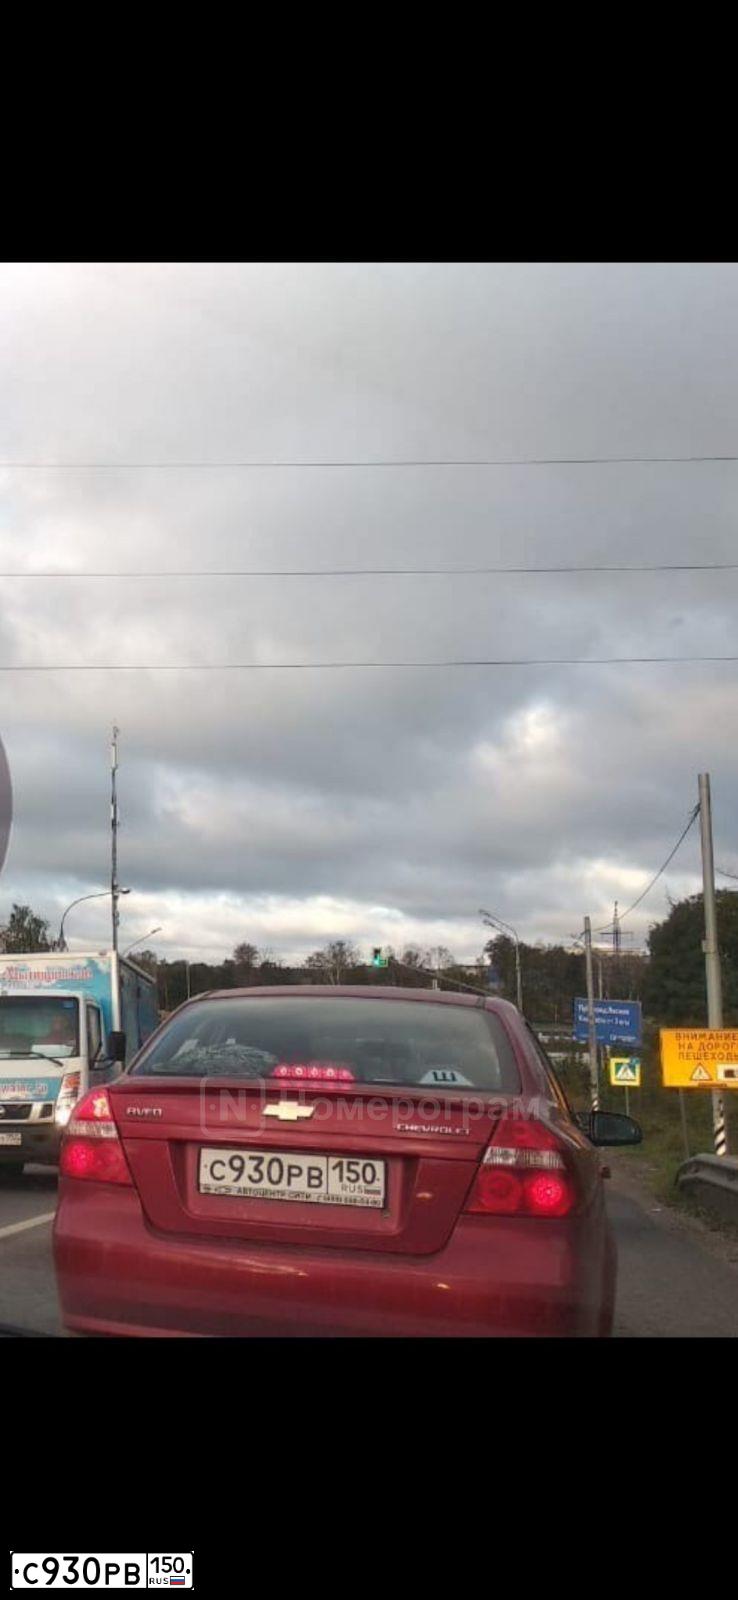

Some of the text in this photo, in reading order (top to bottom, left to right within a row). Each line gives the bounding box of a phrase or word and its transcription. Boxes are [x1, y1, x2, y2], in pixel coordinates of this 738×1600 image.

[675, 1032, 737, 1041] ВНИМАНИЕ
[678, 1042, 738, 1051] НА ДОРОГ
[396, 1122, 470, 1136] CHEVROLET
[209, 1154, 376, 1189] С930РВ 150
[237, 1186, 286, 1198] АВТОЦЕНТР
[340, 1184, 364, 1195] RUS
